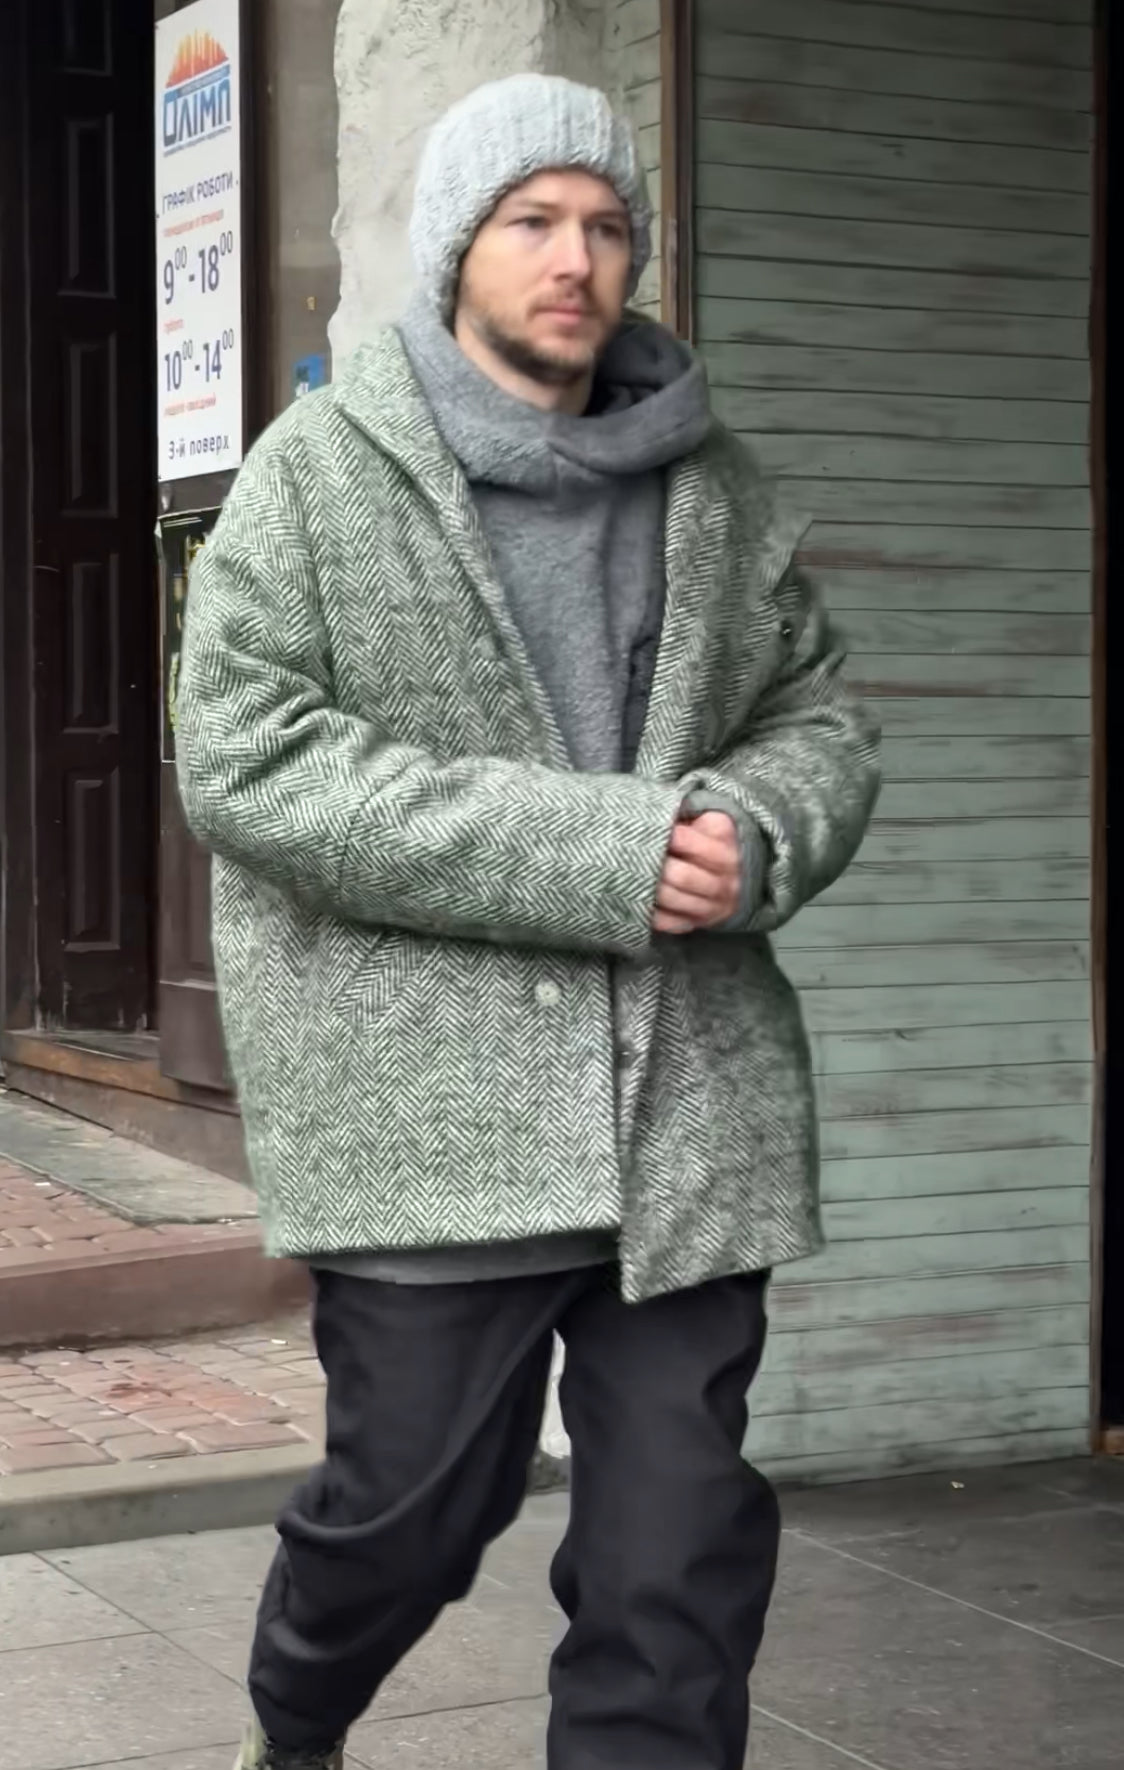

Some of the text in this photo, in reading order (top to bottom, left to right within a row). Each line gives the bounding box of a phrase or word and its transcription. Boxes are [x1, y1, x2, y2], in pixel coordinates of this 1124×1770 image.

[163, 78, 231, 148] ОЛІМП
[162, 171, 233, 215] ГРАФІК РОБОТИ
[168, 435, 230, 460] 3-й поверх
